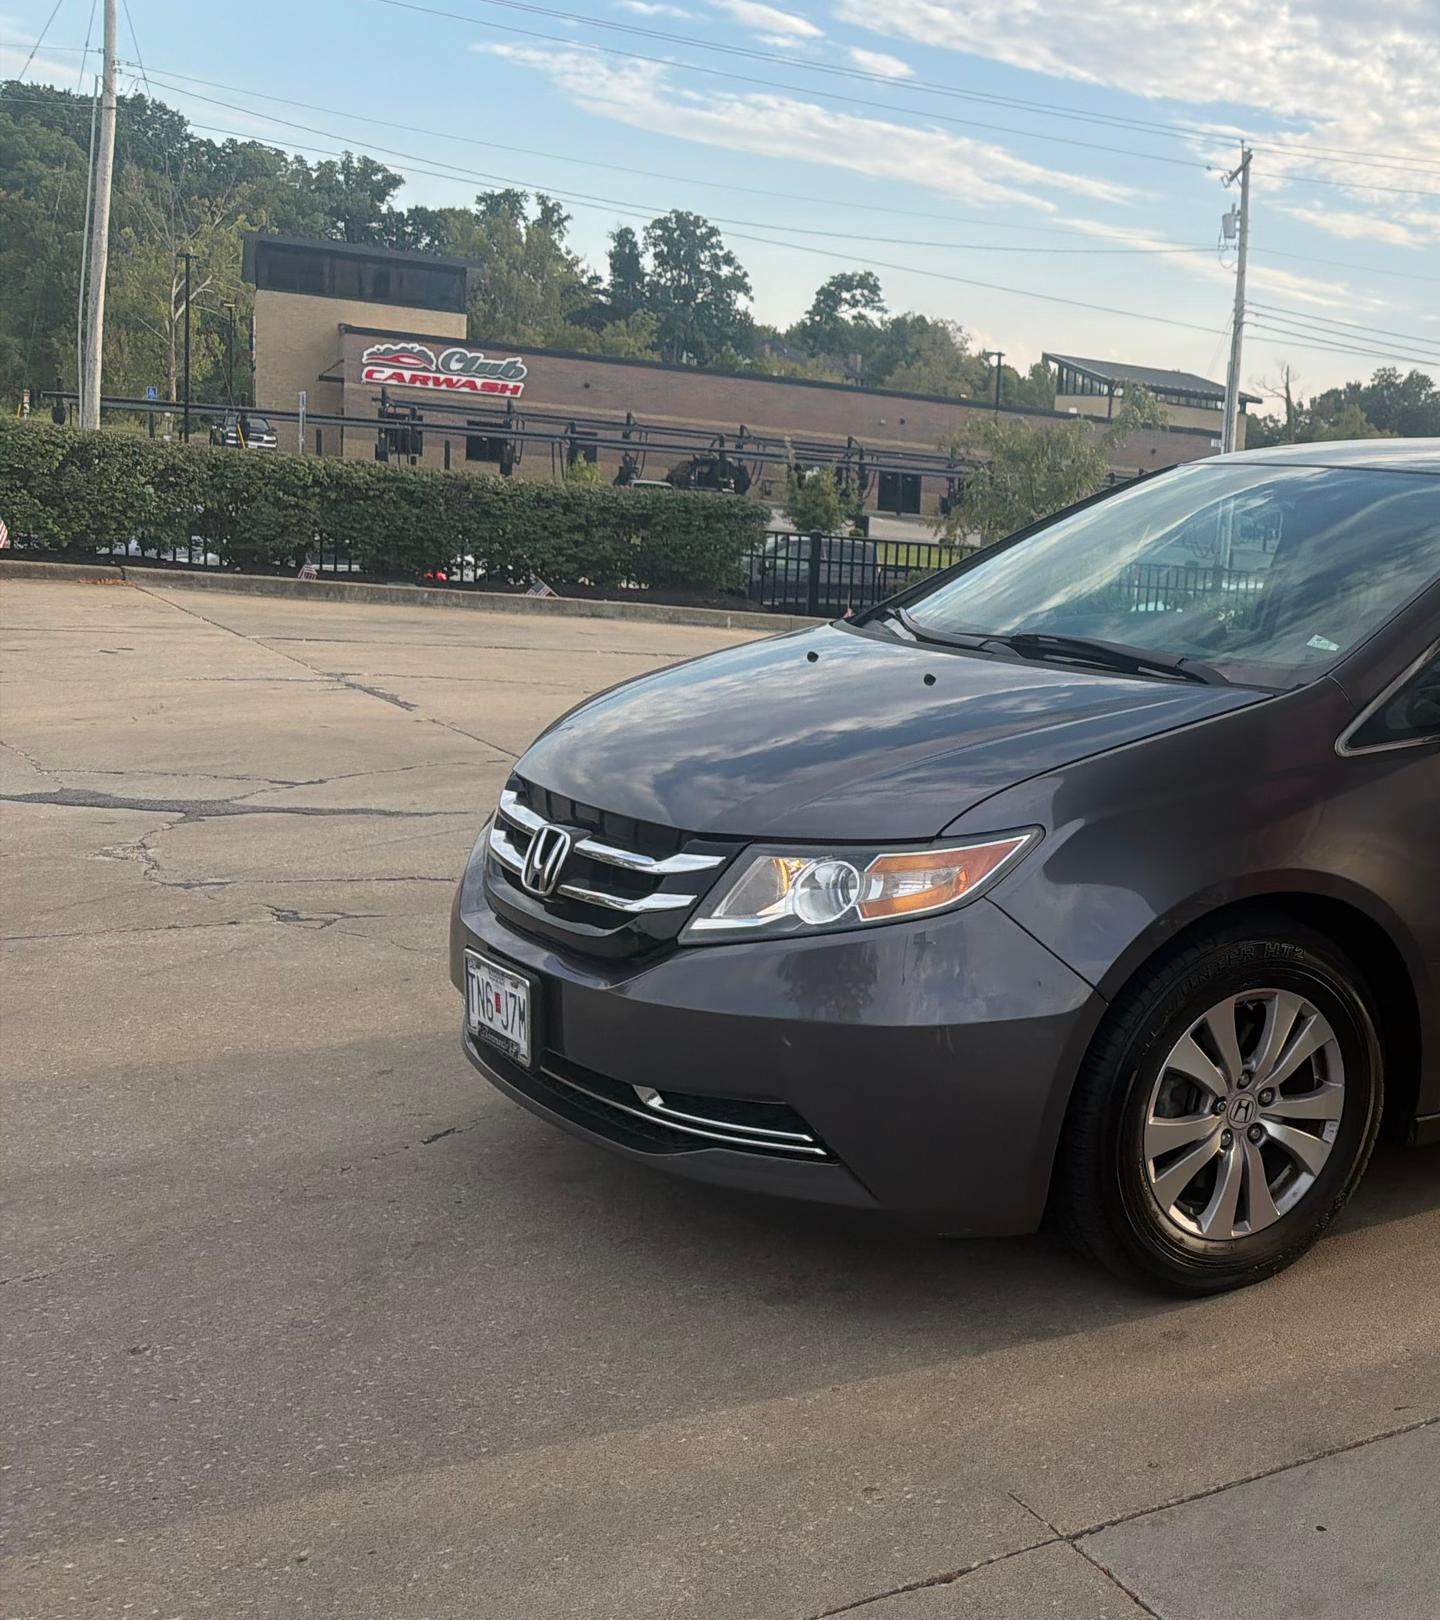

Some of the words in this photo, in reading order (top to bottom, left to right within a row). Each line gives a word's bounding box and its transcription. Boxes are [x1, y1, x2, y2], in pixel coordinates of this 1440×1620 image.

[439, 349, 527, 380] Club
[363, 367, 523, 397] CARWASH
[468, 972, 494, 1022] TN6
[501, 990, 526, 1041] J7M
